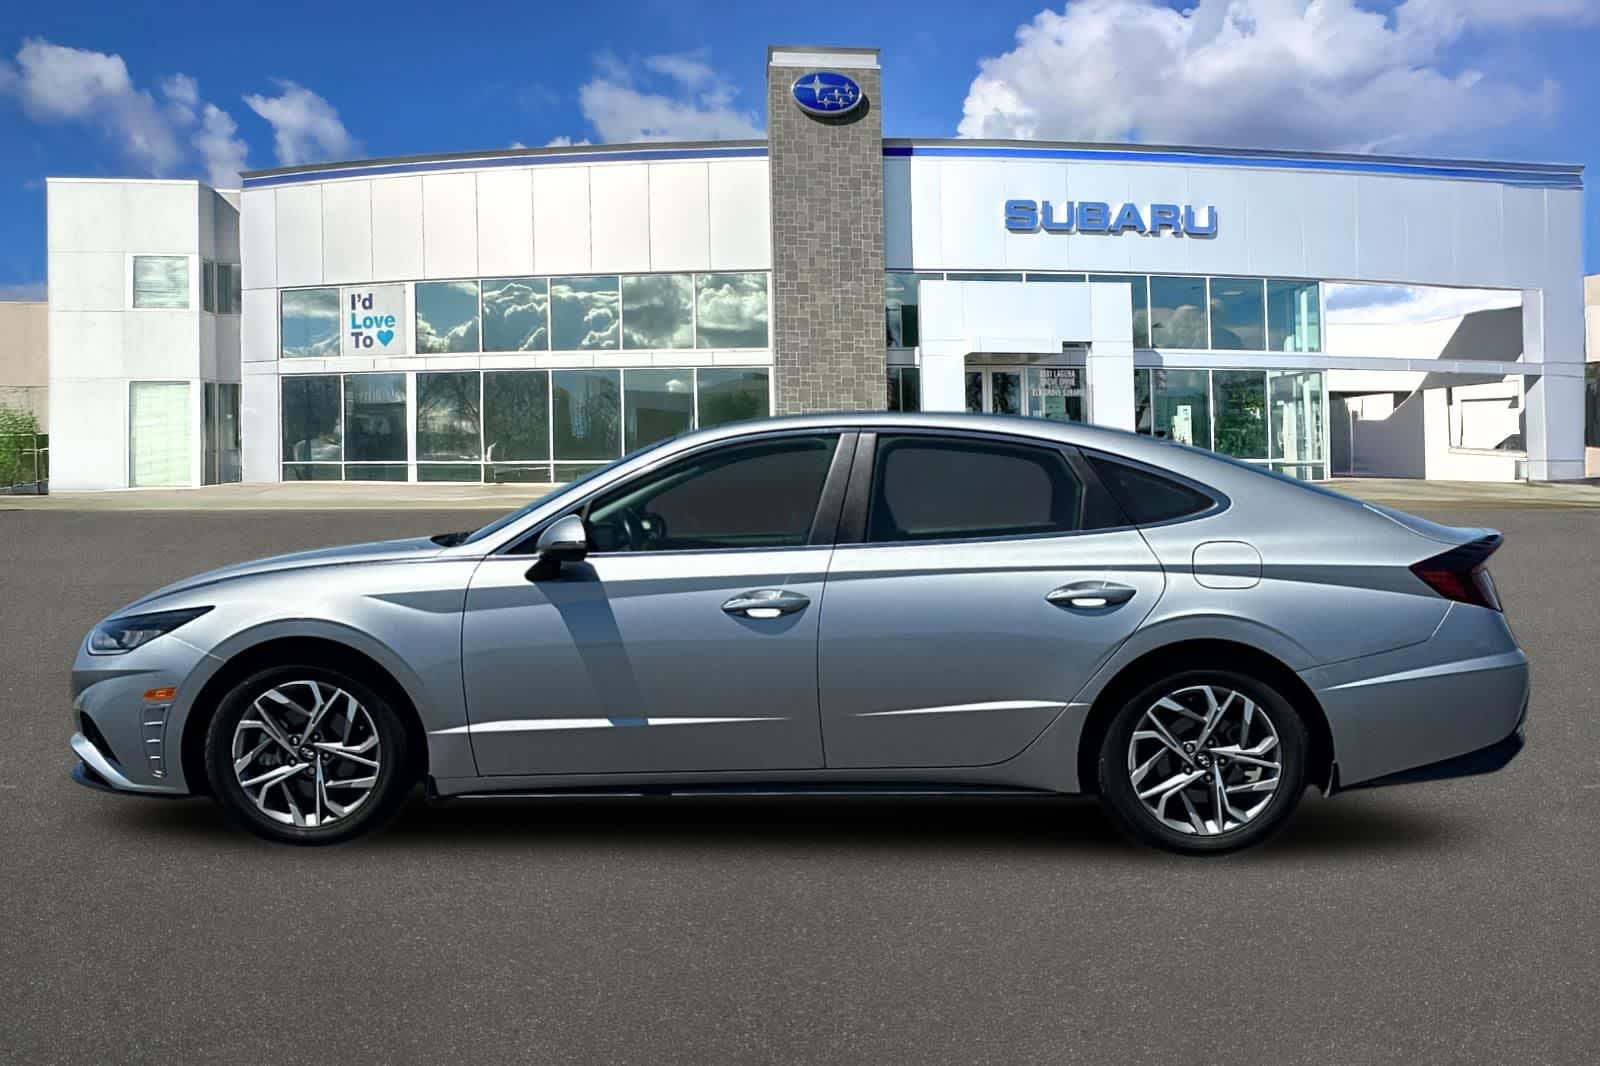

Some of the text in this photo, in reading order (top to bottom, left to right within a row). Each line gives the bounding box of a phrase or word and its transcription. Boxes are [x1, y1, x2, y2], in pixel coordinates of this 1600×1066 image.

[1005, 200, 1217, 238] SUBARU
[351, 293, 373, 310] I’d
[351, 312, 396, 329] Love
[351, 331, 373, 348] To
